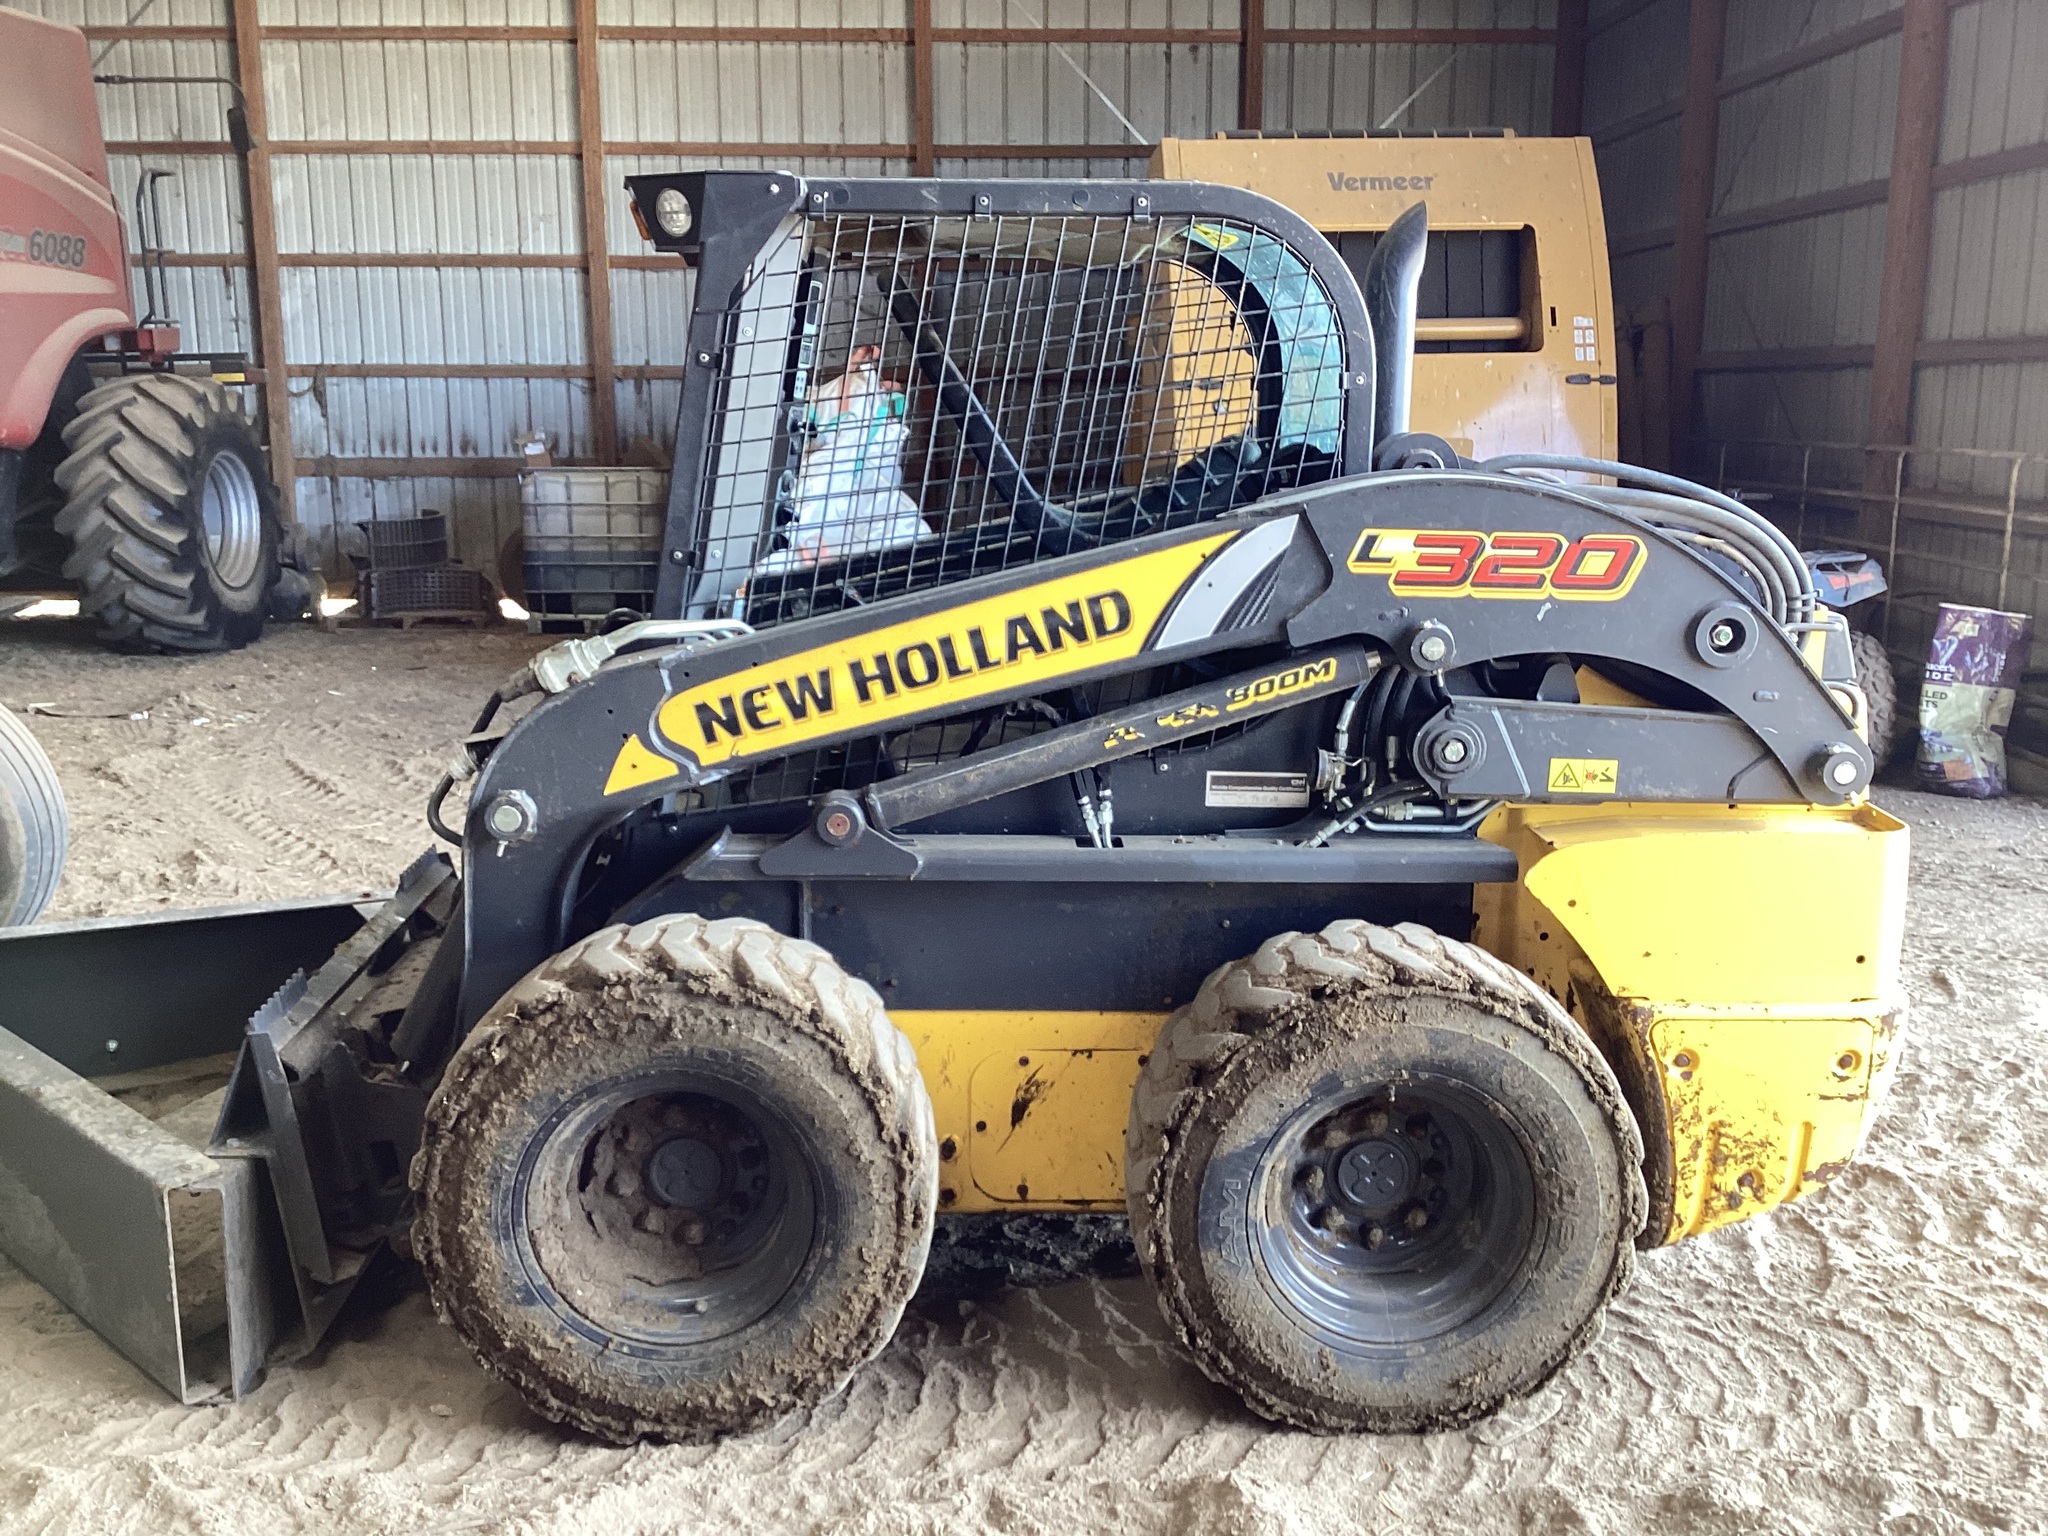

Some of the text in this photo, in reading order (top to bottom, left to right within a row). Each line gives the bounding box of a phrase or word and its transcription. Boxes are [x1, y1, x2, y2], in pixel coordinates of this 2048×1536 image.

[1326, 171, 1434, 191] Vermeer
[29, 228, 86, 268] 6088
[1350, 531, 1645, 597] L320
[693, 588, 1134, 747] NEW HOLLAND
